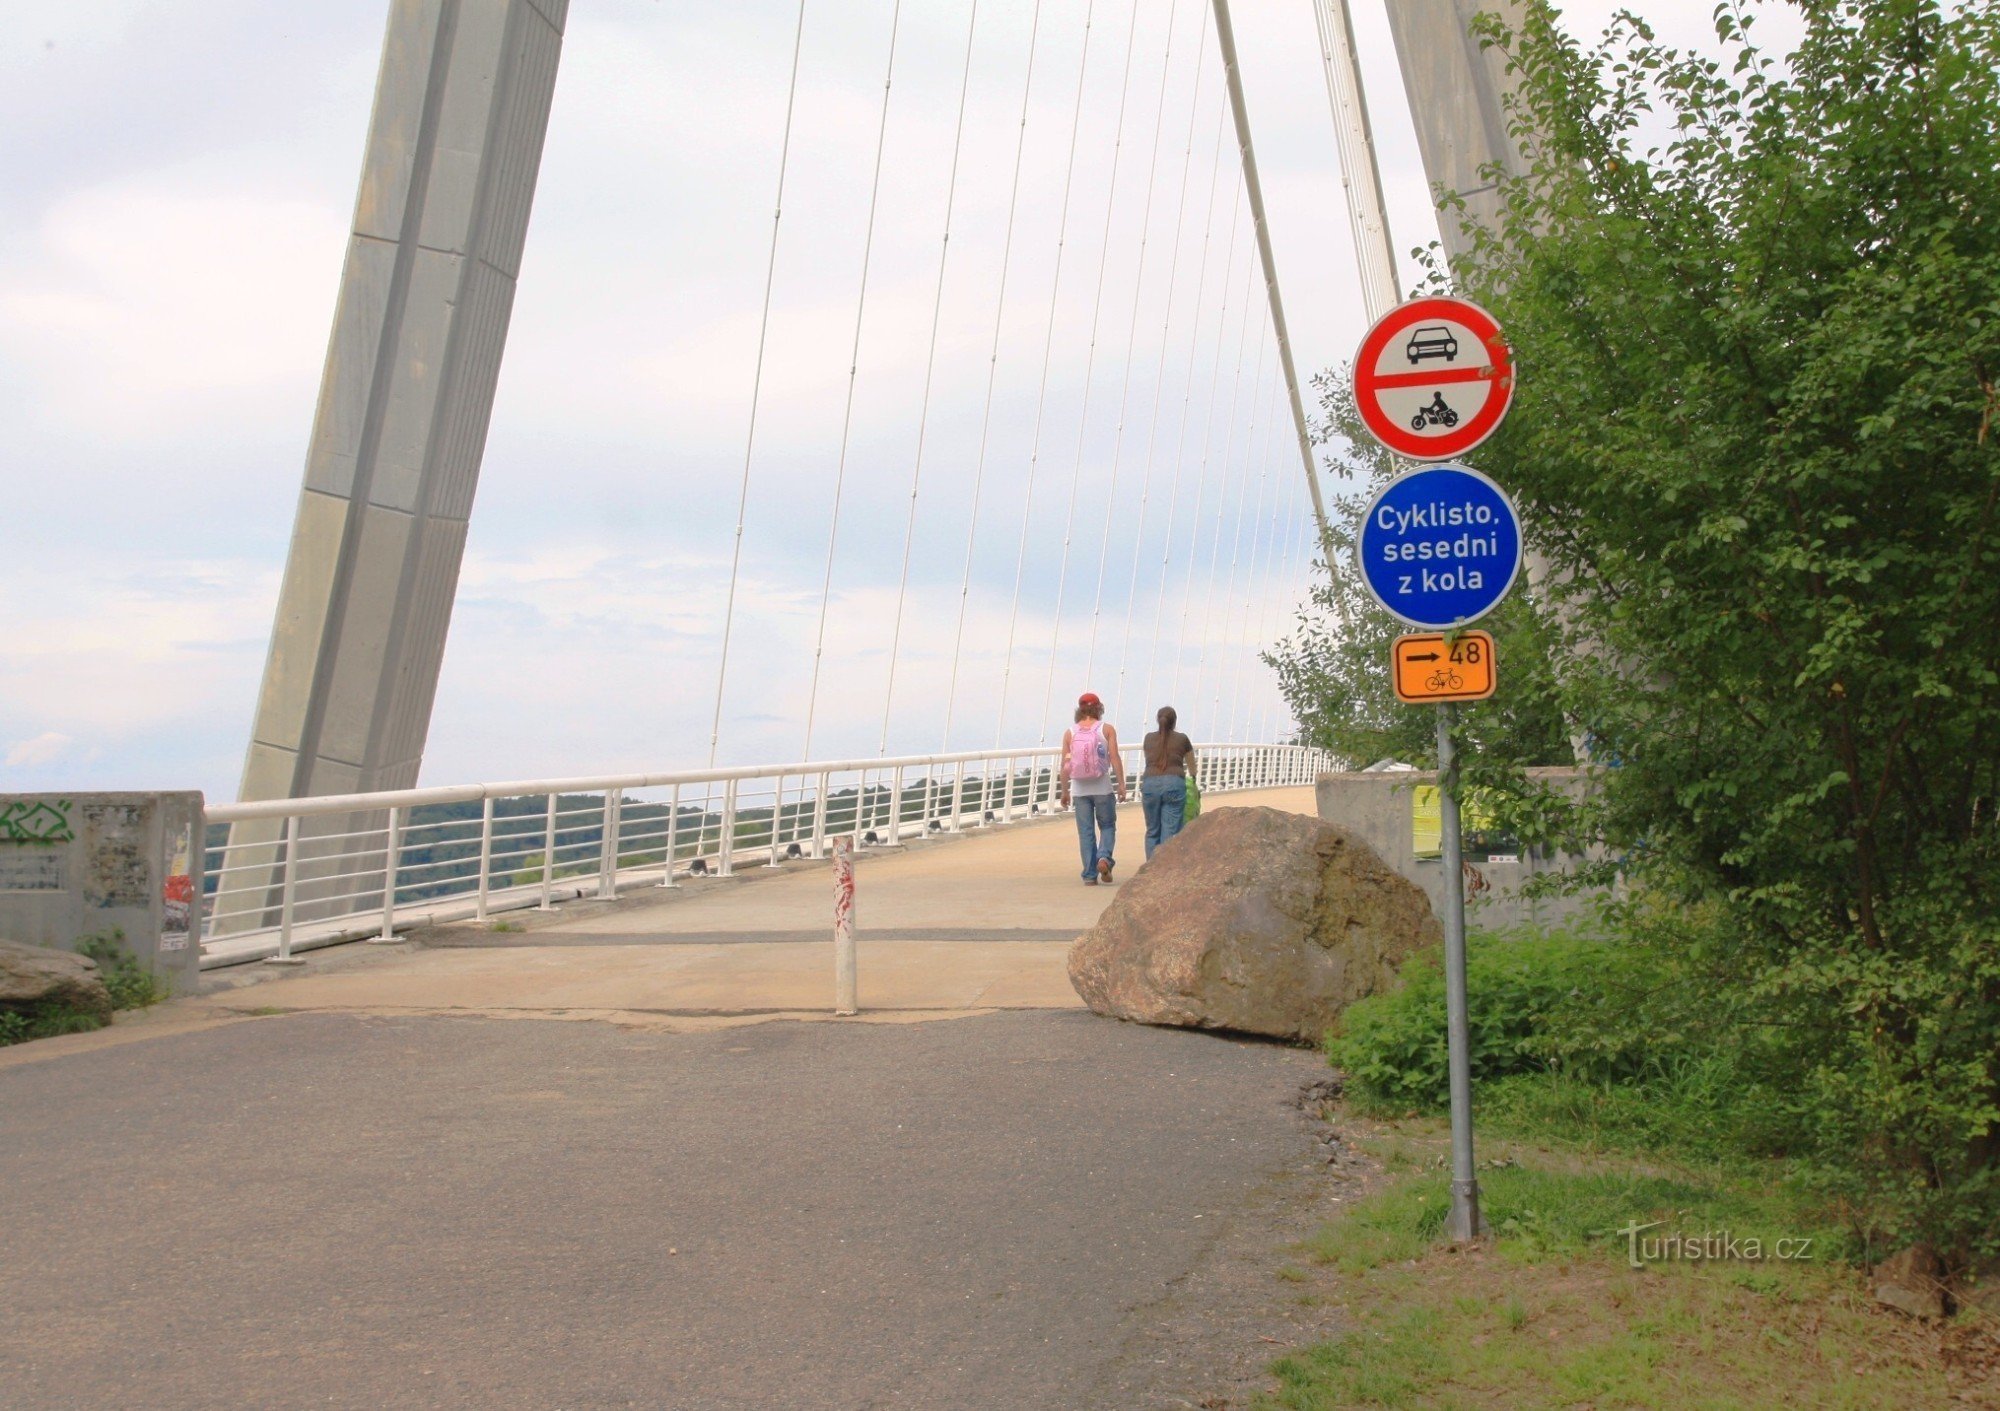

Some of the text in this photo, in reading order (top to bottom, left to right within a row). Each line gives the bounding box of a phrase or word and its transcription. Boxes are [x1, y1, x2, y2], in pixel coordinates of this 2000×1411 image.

[1377, 502, 1499, 535] Cyklisto,
[1383, 531, 1497, 562] sesedni
[1398, 566, 1483, 594] z kola
[1449, 642, 1480, 665] 48
